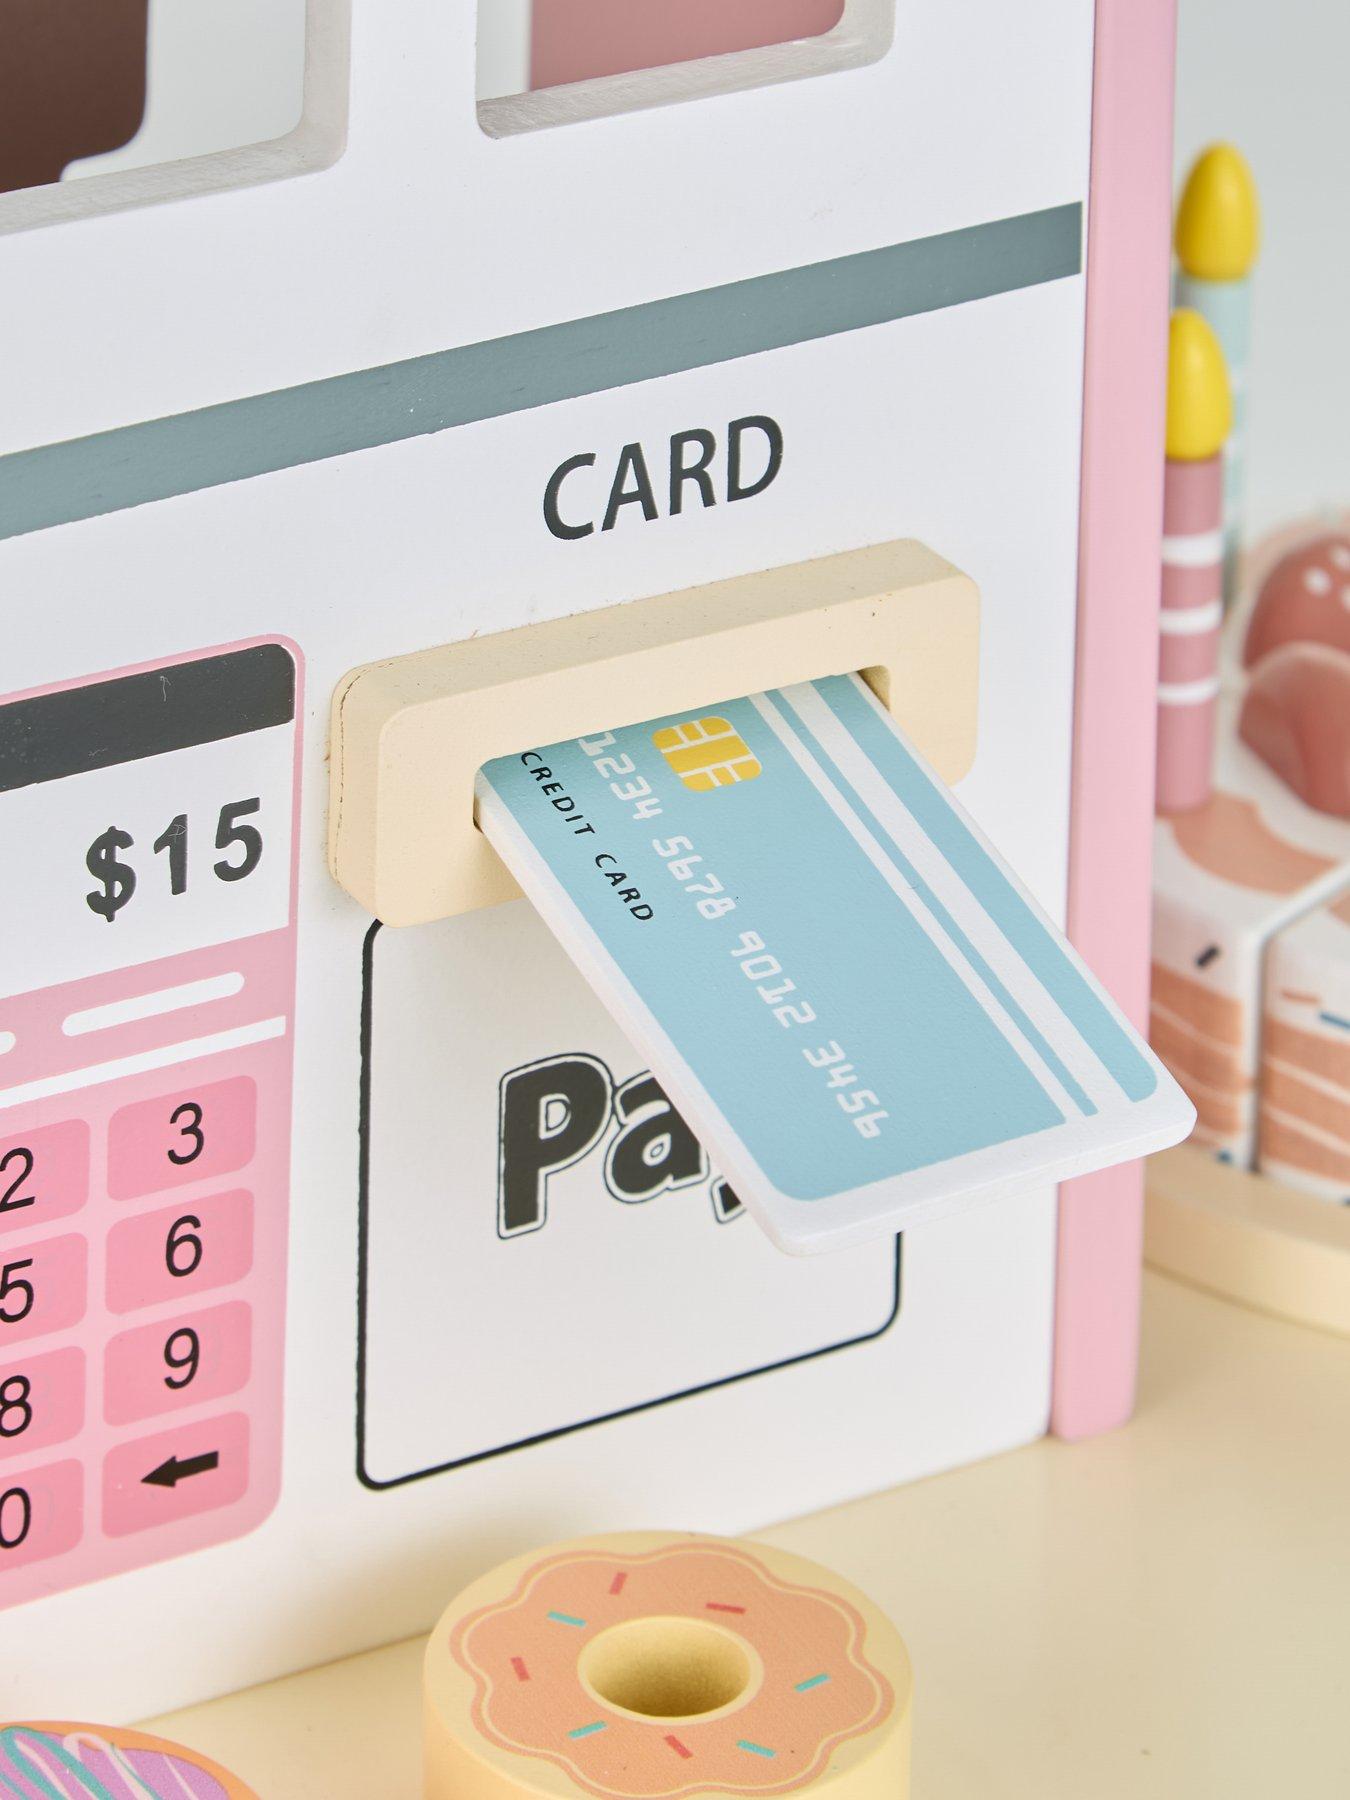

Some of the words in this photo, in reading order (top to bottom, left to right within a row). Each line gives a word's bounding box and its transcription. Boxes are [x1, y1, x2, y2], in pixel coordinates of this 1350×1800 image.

[542, 414, 784, 540] CARD
[85, 797, 263, 923] $15
[520, 751, 596, 835] CREDIT
[595, 853, 654, 921] CARD
[578, 731, 664, 820] 1234
[652, 835, 740, 920] 5678
[731, 930, 818, 1028] 9012
[803, 1041, 890, 1139] 3456
[167, 1102, 205, 1165] 3
[497, 1052, 747, 1240] Pa
[0, 1147, 36, 1213] 2
[165, 1215, 204, 1277] 6
[0, 1258, 35, 1323] 5
[163, 1327, 200, 1390] 9
[0, 1374, 33, 1438] 8
